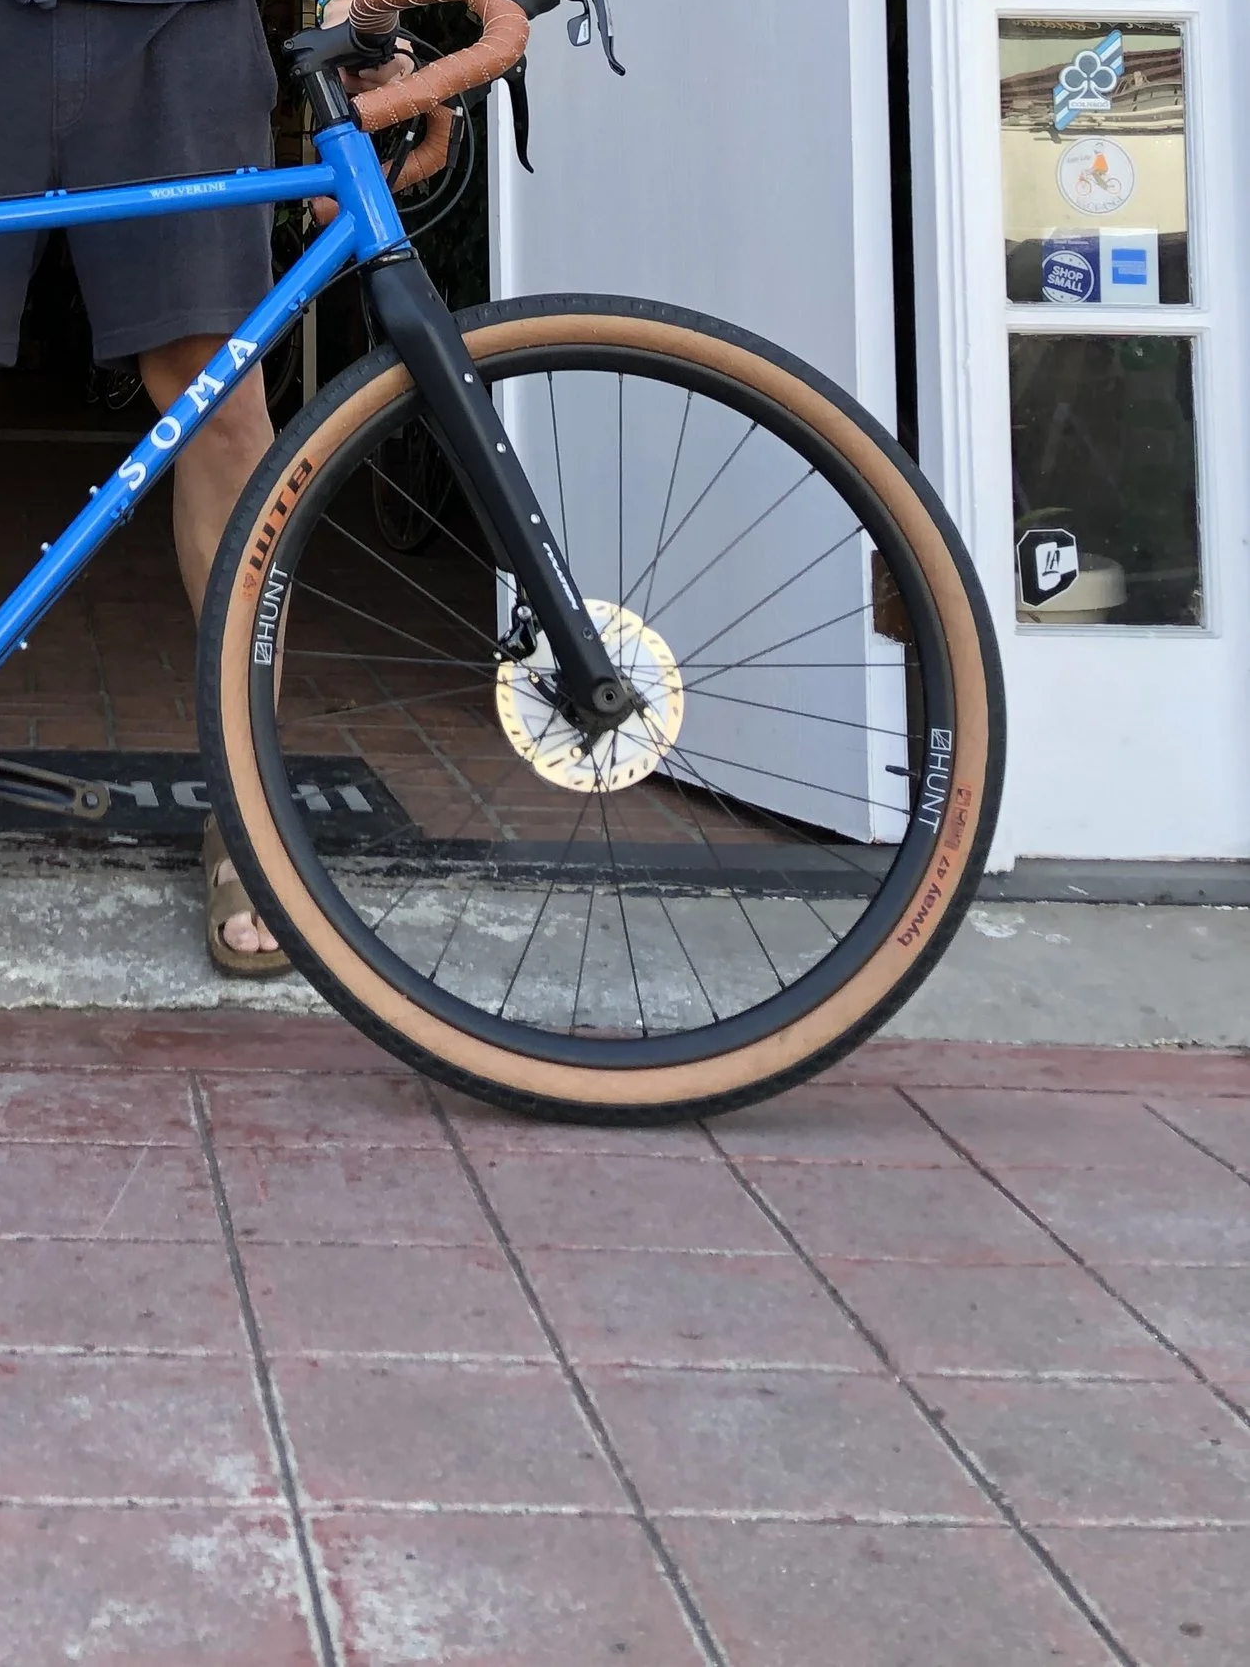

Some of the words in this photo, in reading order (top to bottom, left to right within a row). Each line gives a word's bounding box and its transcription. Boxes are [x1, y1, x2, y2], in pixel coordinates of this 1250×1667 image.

[150, 181, 226, 198] WOLVERINE
[1047, 274, 1083, 293] SMALL
[1052, 265, 1083, 281] SHOP
[118, 338, 258, 491] SOMA
[257, 561, 289, 641] HUNT
[918, 752, 952, 835] HUNT
[897, 882, 942, 947] byway
[937, 855, 951, 880] 47
